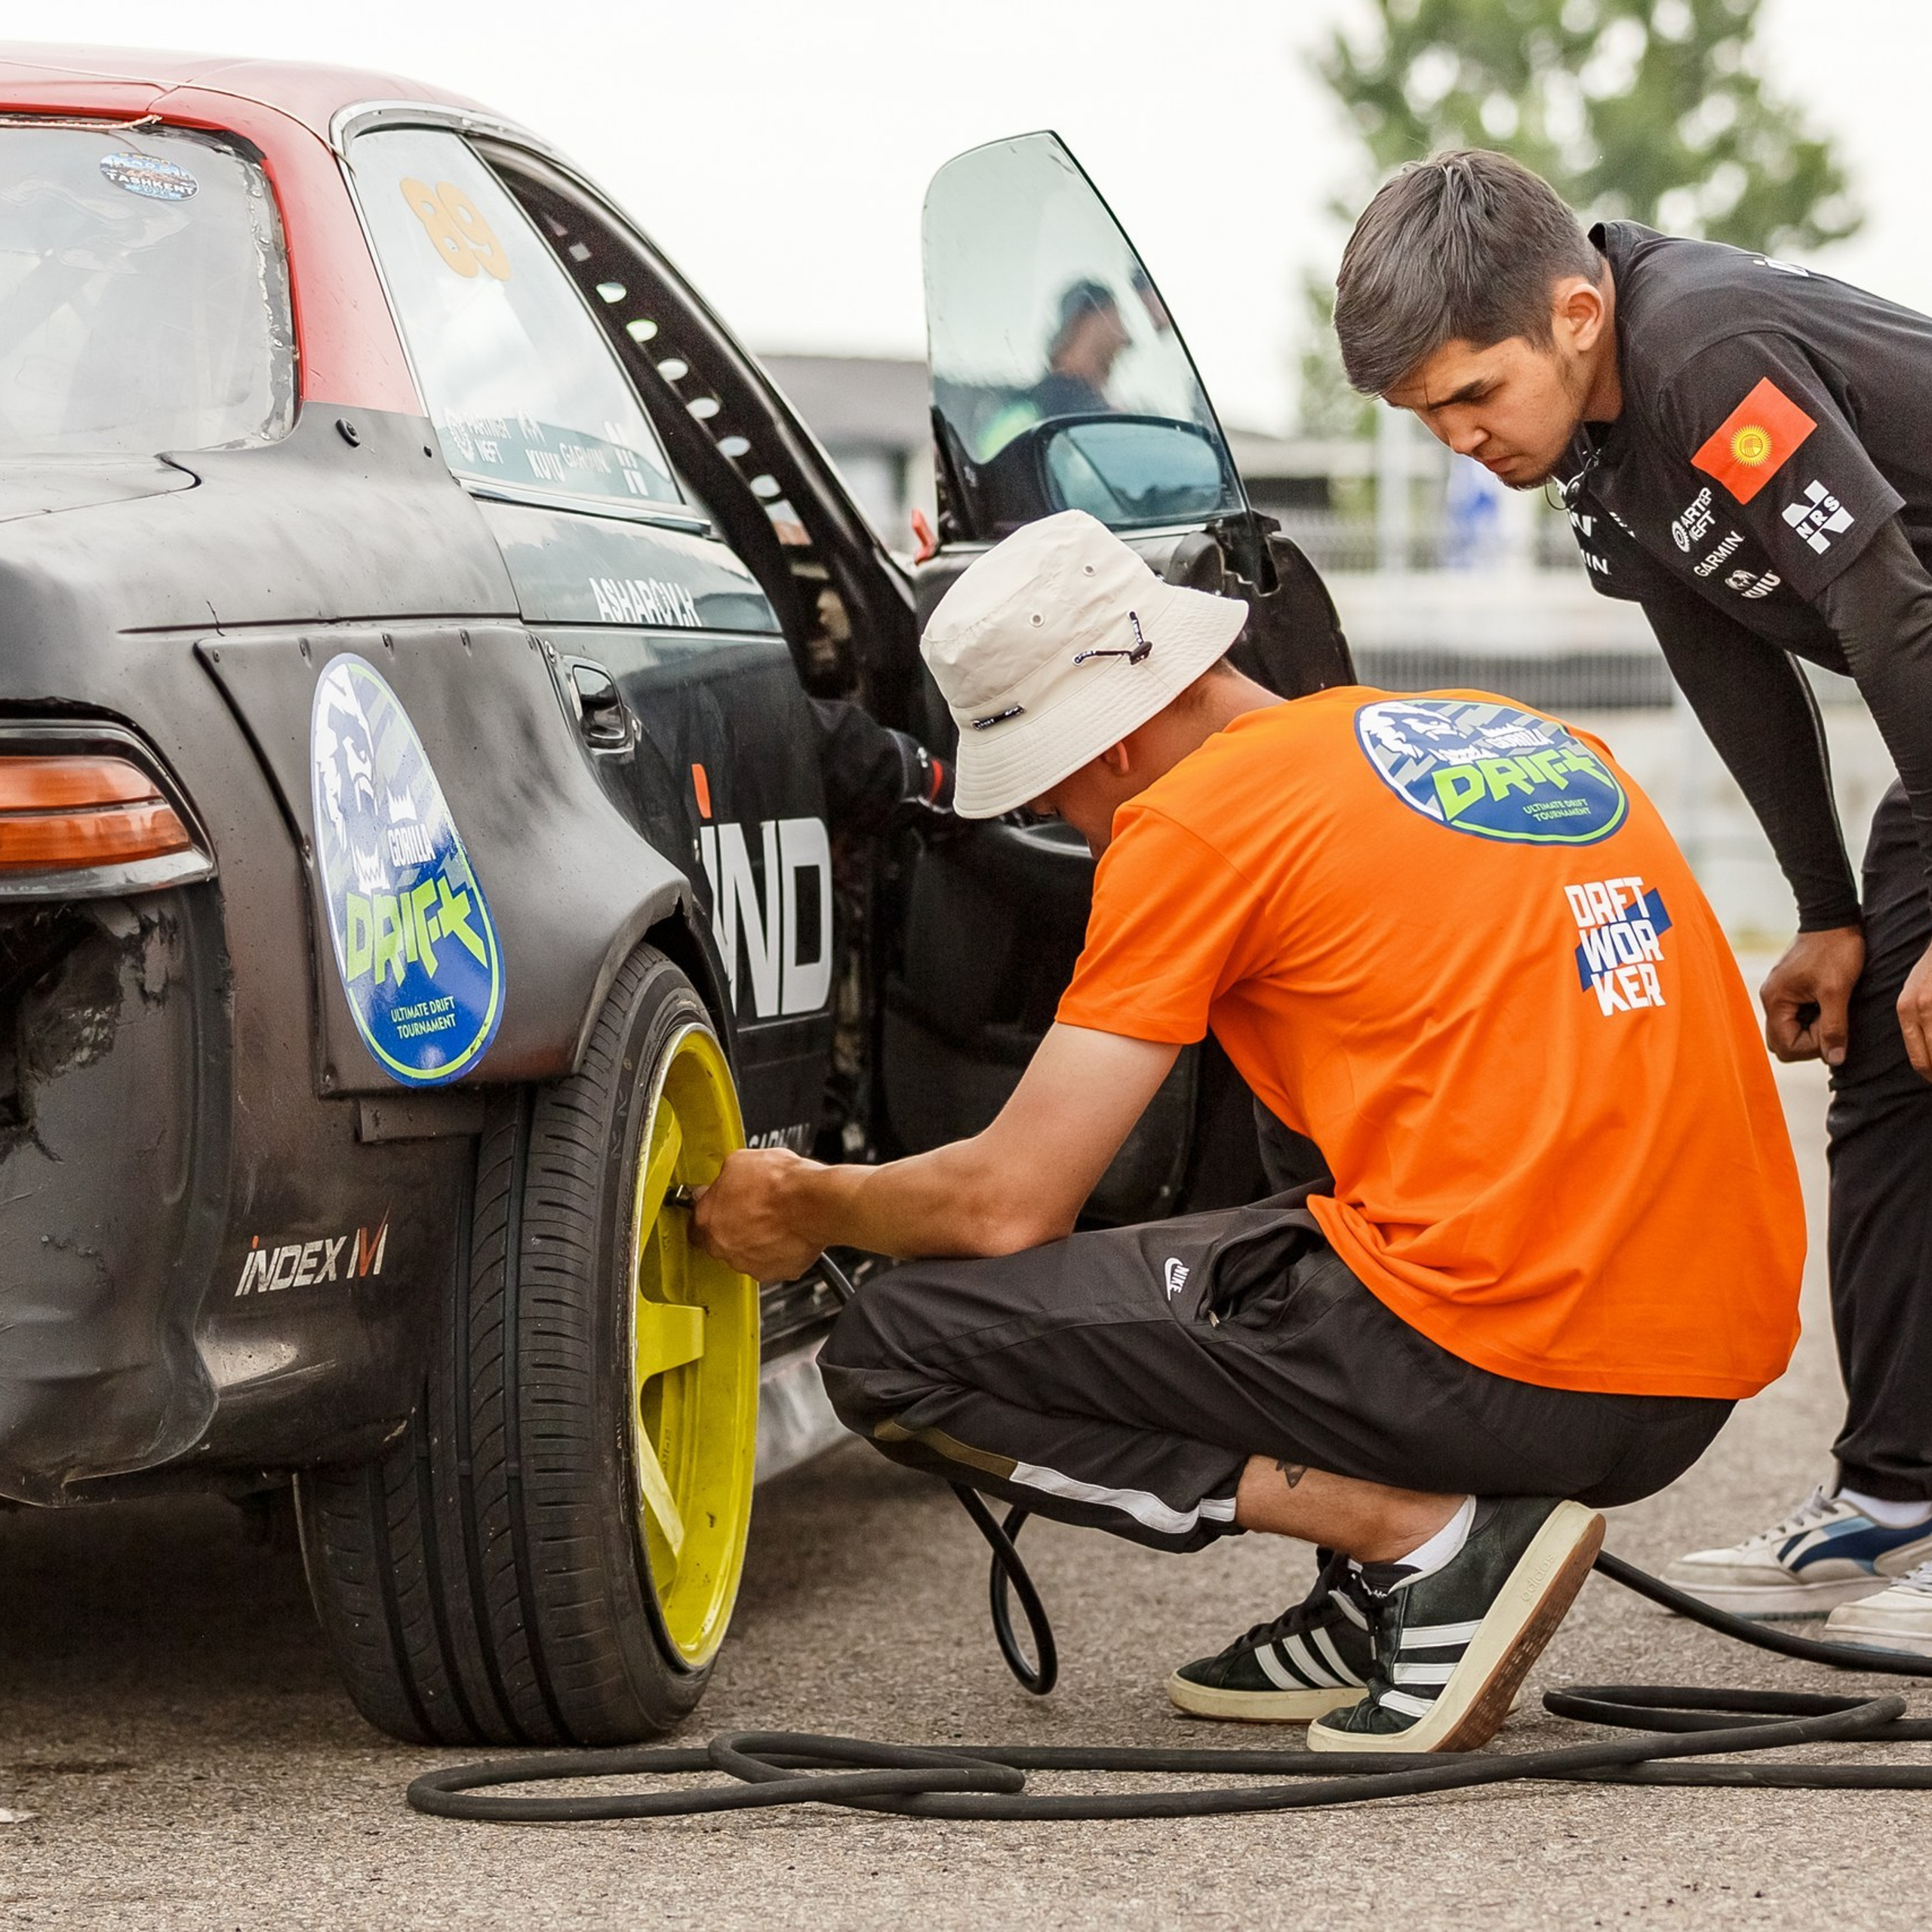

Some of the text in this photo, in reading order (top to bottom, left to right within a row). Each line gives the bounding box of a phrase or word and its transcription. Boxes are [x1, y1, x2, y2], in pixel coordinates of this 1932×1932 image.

[106, 172, 194, 195] TASHKENT
[400, 177, 512, 280] 89
[1693, 531, 1745, 577] GARMIN
[1484, 728, 1555, 749] GORILLA
[1432, 749, 1615, 821] DRIFT
[1523, 798, 1589, 814] ULTIMATE DRIFT
[1532, 807, 1592, 823] TOURNAMENT
[387, 823, 437, 867] GORILLA
[1564, 876, 1651, 928] DRFT
[346, 875, 488, 987] DRIFT
[1579, 919, 1665, 973] WOR
[391, 995, 455, 1023] ULTIMATE DRIFT
[1590, 963, 1666, 1017] KER
[396, 1013, 456, 1039] TOURNAMENT
[1171, 1265, 1189, 1293] NIKE
[1520, 1555, 1555, 1602] adidas
